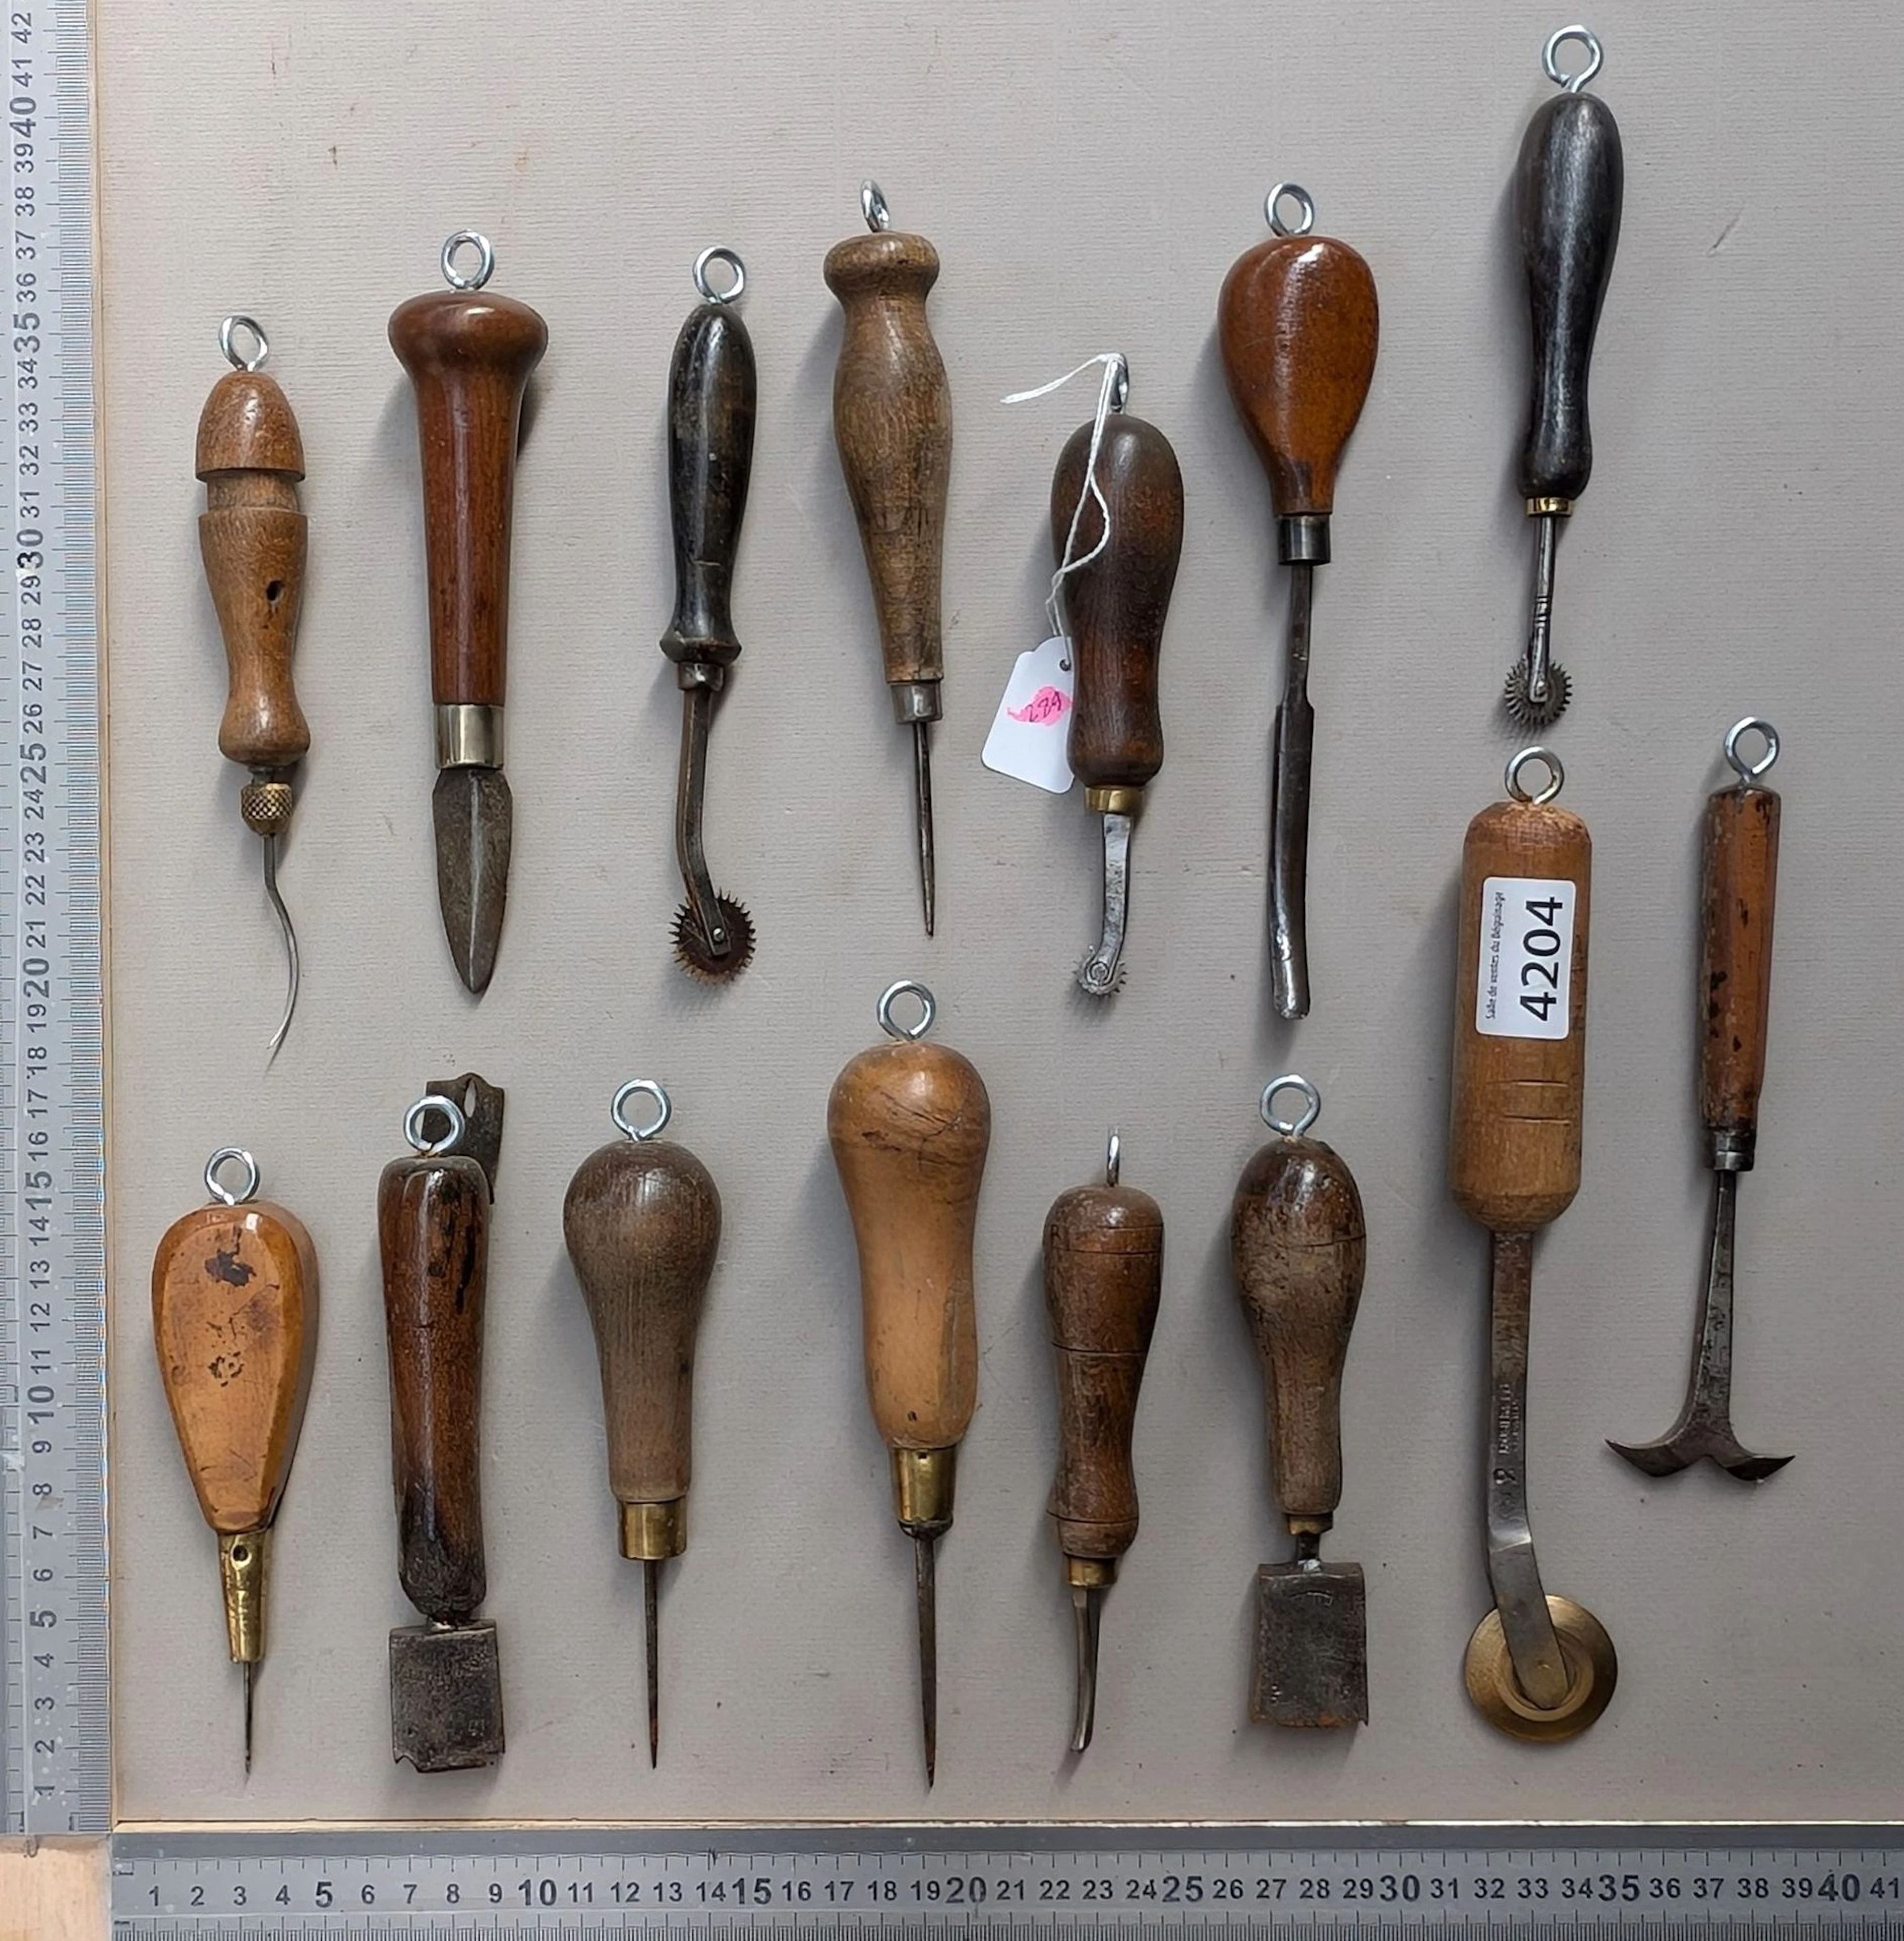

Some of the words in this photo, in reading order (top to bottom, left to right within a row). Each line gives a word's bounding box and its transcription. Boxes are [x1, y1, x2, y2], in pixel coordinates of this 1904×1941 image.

[11, 13, 32, 44] 42
[11, 59, 33, 87] 41
[9, 97, 36, 138] 40
[14, 143, 34, 173] 39
[14, 187, 35, 216] 38
[15, 231, 36, 260] 37
[16, 273, 36, 302] 36
[13, 313, 40, 353] 35
[17, 358, 38, 389] 34
[18, 403, 38, 432] 33
[19, 446, 39, 475] 32
[19, 492, 40, 518] 31
[17, 529, 44, 569] 30
[20, 576, 41, 605] 29
[22, 619, 42, 648] 28
[22, 661, 42, 691] 27
[23, 704, 43, 734] 26
[20, 743, 46, 784] 25
[23, 789, 44, 820] 24
[24, 832, 45, 863] 23
[25, 875, 45, 905] 22
[25, 921, 46, 948] 21
[1490, 941, 1500, 953] du
[1490, 955, 1499, 983] ventes
[1520, 897, 1563, 1021] 4204
[23, 958, 49, 998] 20
[1488, 986, 1497, 997] de
[26, 1004, 47, 1033] 19
[1486, 999, 1496, 1019] Salle
[27, 1047, 47, 1075] 18
[27, 1089, 48, 1118] 17
[28, 1132, 49, 1162] 16
[24, 1172, 52, 1210] 15
[28, 1216, 50, 1246] 14
[29, 1260, 50, 1289] 13
[30, 1303, 51, 1332] 12
[30, 1351, 51, 1374] 11
[27, 1386, 54, 1424] 10
[32, 1441, 52, 1453] 9
[33, 1483, 52, 1496] 8
[33, 1526, 53, 1539] 7
[33, 1569, 53, 1582] 6
[30, 1611, 57, 1628] 5
[34, 1653, 54, 1668] 4
[34, 1697, 55, 1710] 3
[34, 1740, 55, 1754] 2
[34, 1786, 55, 1796] 1
[149, 1885, 159, 1907] 1
[191, 1886, 204, 1906] 2
[234, 1886, 246, 1906] 3
[275, 1884, 291, 1905] 4
[316, 1882, 333, 1908] 5
[361, 1884, 375, 1904] 6
[404, 1884, 417, 1904] 7
[447, 1883, 460, 1904] 8
[489, 1883, 502, 1904] 9
[519, 1879, 557, 1906] 10
[568, 1882, 593, 1903] 11
[611, 1882, 640, 1903] 12
[654, 1882, 682, 1902] 13
[696, 1882, 726, 1902] 14
[732, 1878, 772, 1904] 15
[782, 1881, 811, 1901] 16
[825, 1881, 854, 1901] 17
[868, 1881, 897, 1901] 18
[911, 1881, 940, 1900] 19
[946, 1877, 986, 1903] 20
[997, 1880, 1023, 1900] 21
[1039, 1880, 1070, 1900] 22
[1082, 1880, 1113, 1900] 23
[1126, 1879, 1157, 1899] 24
[1162, 1876, 1203, 1902] 25
[1213, 1879, 1243, 1899] 26
[1256, 1879, 1287, 1899] 27
[1300, 1879, 1330, 1899] 28
[1343, 1879, 1373, 1899] 29
[1380, 1875, 1420, 1902] 30
[1430, 1878, 1458, 1899] 31
[1474, 1878, 1505, 1898] 32
[1518, 1878, 1548, 1898] 33
[1562, 1878, 1593, 1898] 34
[1599, 1875, 1640, 1901] 35
[1650, 1878, 1680, 1898] 36
[1693, 1878, 1724, 1899] 37
[1737, 1878, 1769, 1898] 38
[1782, 1878, 1812, 1898] 39
[1818, 1874, 1860, 1901] 40
[1870, 1878, 1898, 1898] 41
